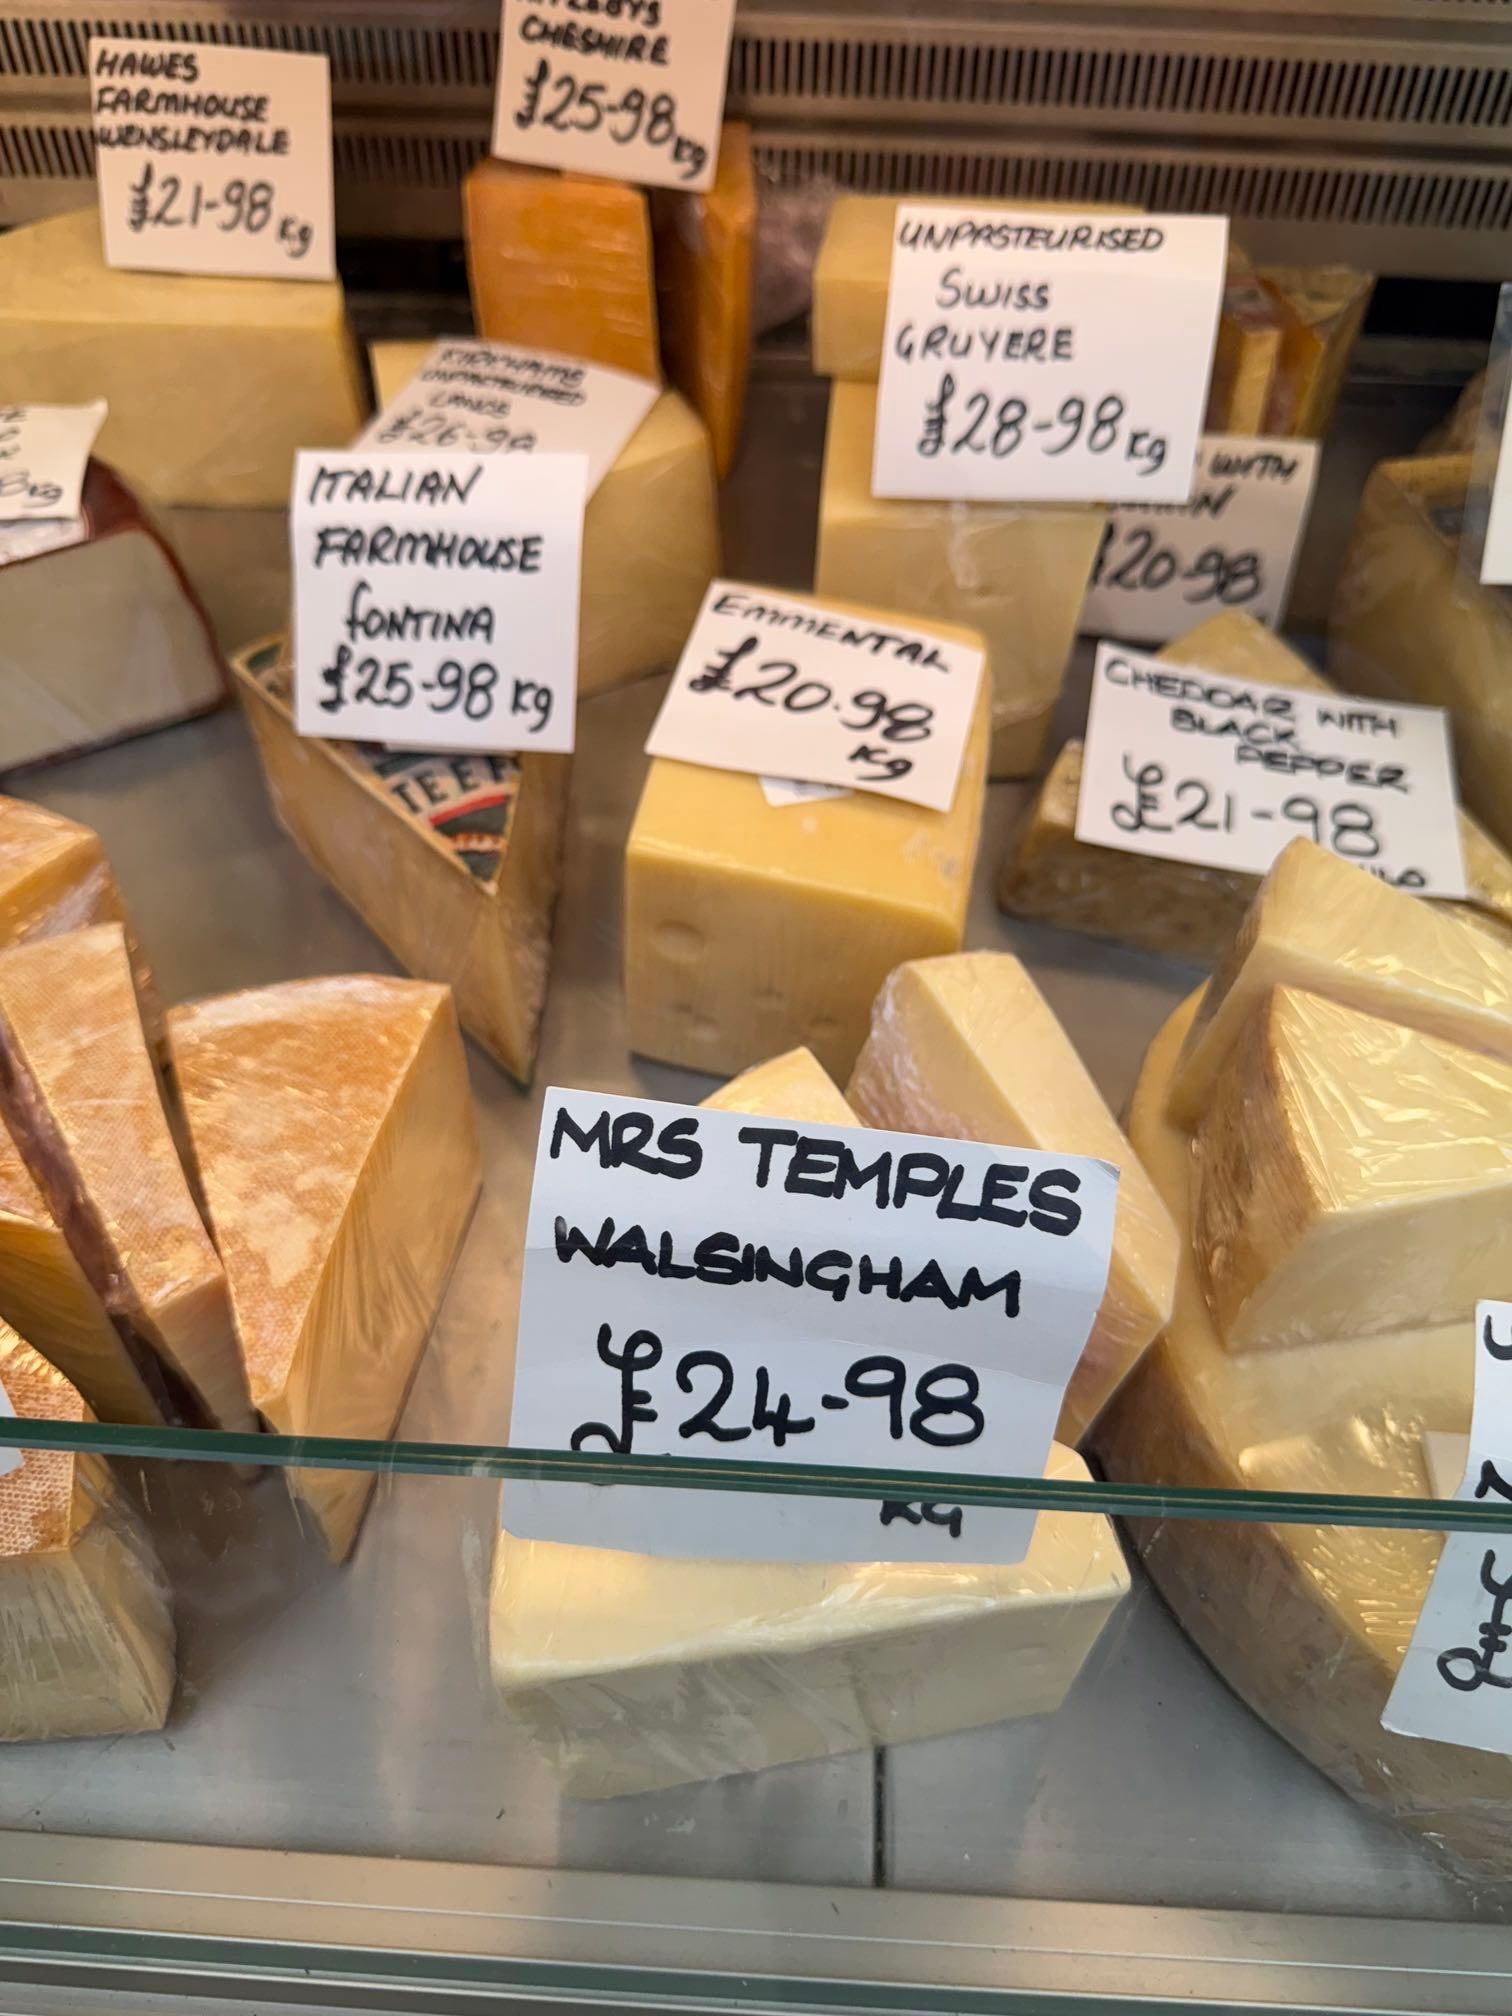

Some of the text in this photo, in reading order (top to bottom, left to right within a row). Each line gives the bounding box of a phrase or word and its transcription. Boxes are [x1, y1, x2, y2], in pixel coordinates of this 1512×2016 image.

[520, 15, 670, 66] CHESHIRE
[95, 50, 199, 83] HAWES
[96, 87, 270, 122] FARMHOUSE
[514, 58, 676, 145] £25-98
[97, 126, 290, 155] WENSLEYDALE
[129, 162, 275, 233] £21-98
[898, 220, 1166, 252] UNPASTEURISED
[895, 323, 1074, 363] GRUYERE
[917, 372, 1124, 458] £28-98
[309, 464, 483, 505] ITALIAN
[314, 526, 544, 573] FARMHOUSE
[319, 644, 499, 721] £25-98
[1104, 656, 1398, 739] CHEDDAR WITH
[1169, 706, 1300, 750] BLACK
[1235, 745, 1409, 794] PEPPER
[1110, 754, 1381, 858] £21-98
[550, 1107, 1082, 1236] MRS TEMPLES
[554, 1215, 1021, 1318] WALSINGHAM
[570, 1322, 985, 1455] £24-98
